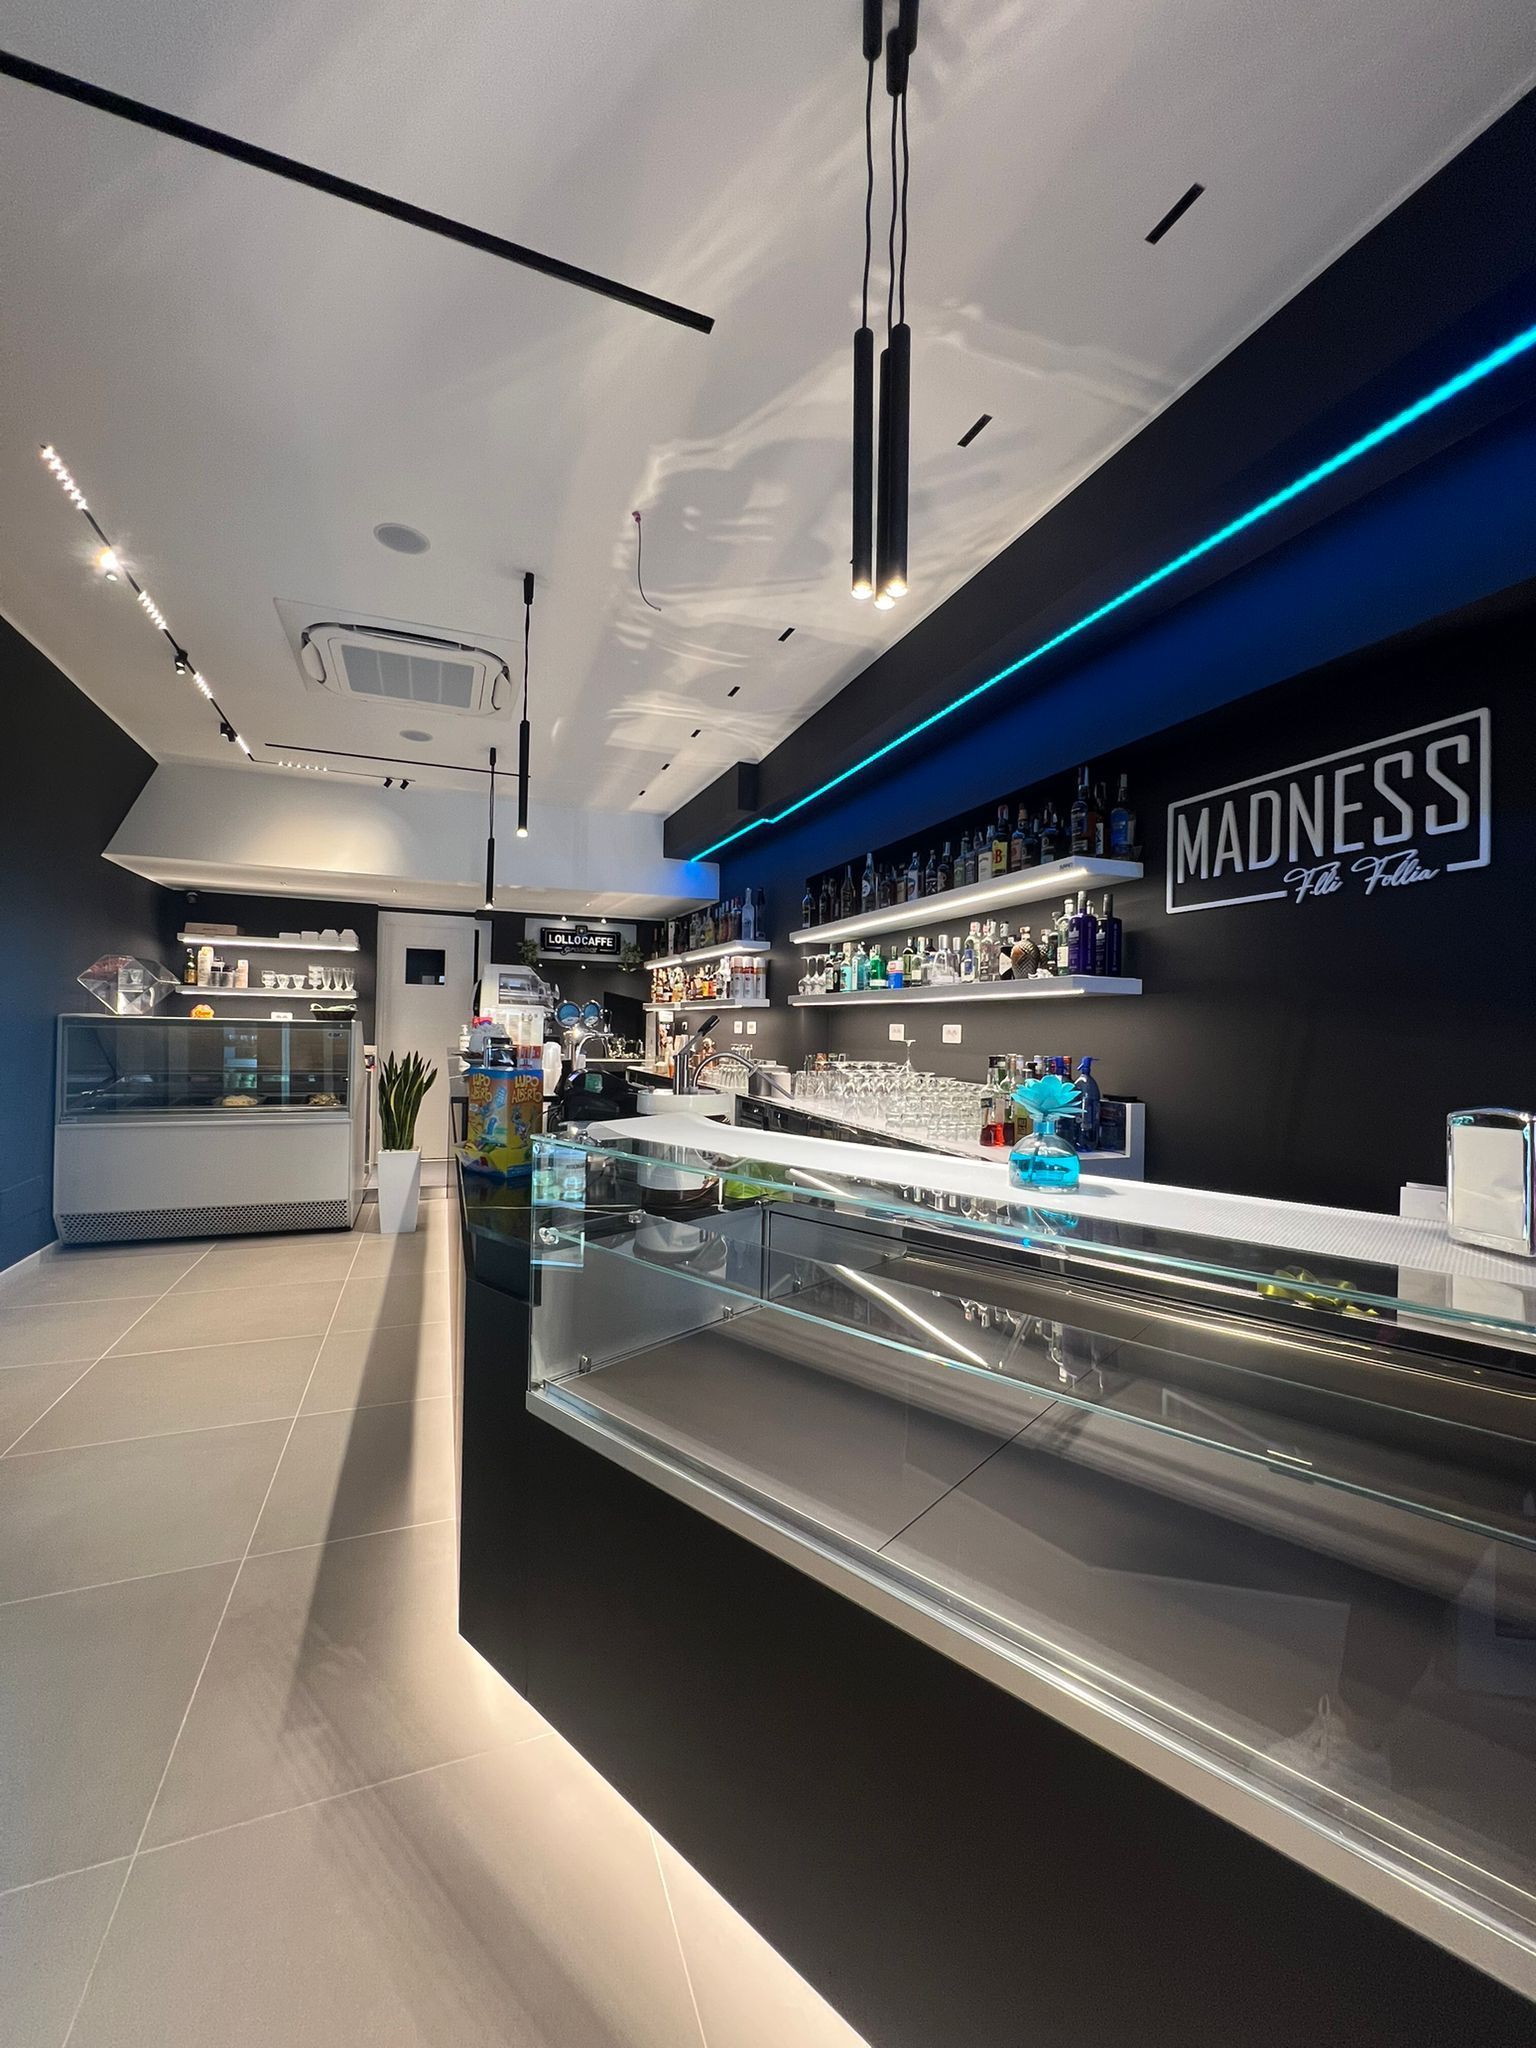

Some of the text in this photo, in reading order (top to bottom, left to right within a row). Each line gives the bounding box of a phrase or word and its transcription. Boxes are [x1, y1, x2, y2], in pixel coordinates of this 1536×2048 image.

[1177, 734, 1470, 884] MADNESS
[1350, 848, 1441, 896] Follia
[472, 1072, 491, 1087] LUPO
[514, 1074, 540, 1088] LUPO
[511, 1087, 543, 1104] ALBERTO
